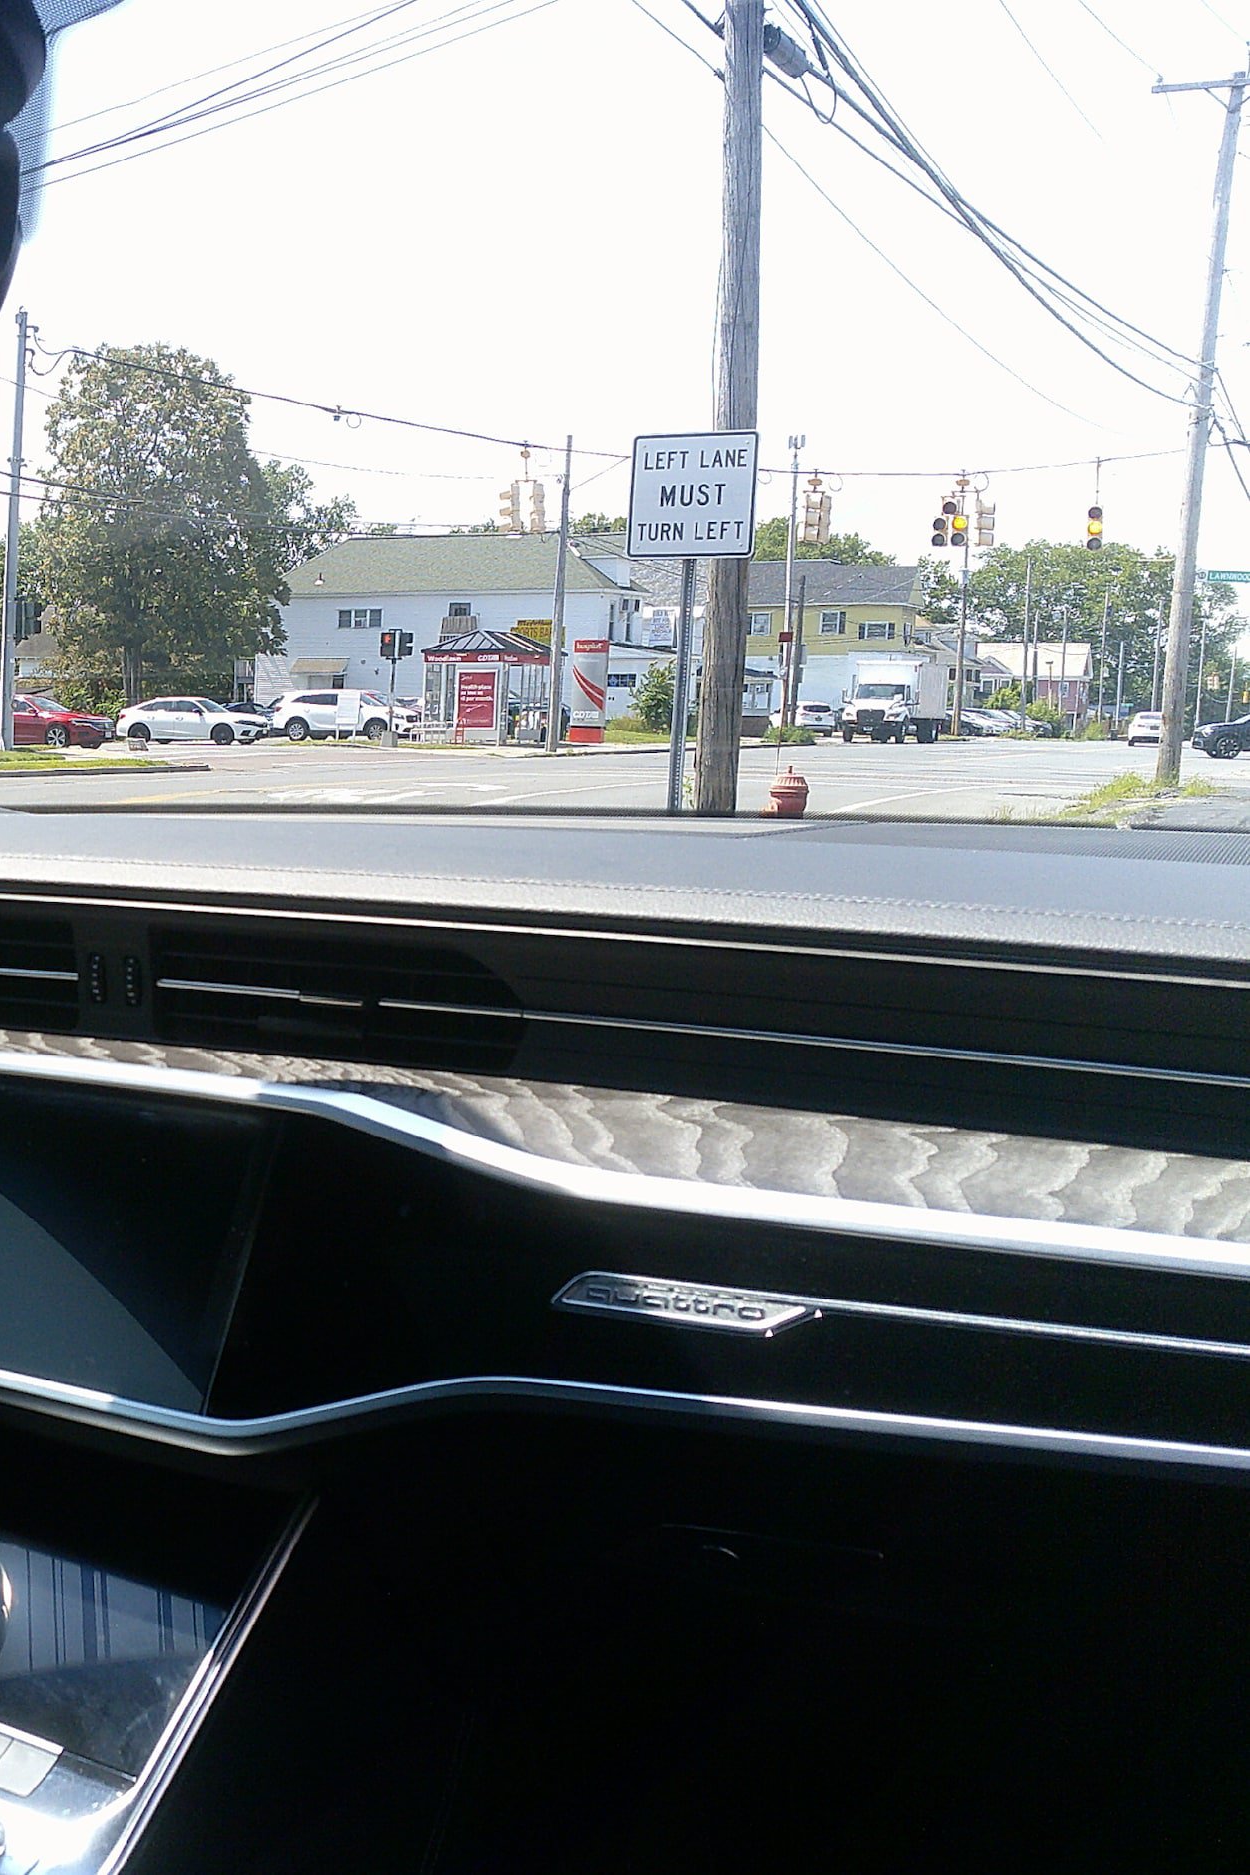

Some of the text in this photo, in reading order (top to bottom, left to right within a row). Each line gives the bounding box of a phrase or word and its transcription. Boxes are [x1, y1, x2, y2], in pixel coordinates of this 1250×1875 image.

[644, 449, 748, 470] LEFT LANE
[660, 484, 726, 507] MUST
[638, 521, 744, 541] TURN LEFT
[586, 1285, 766, 1321] quattro
